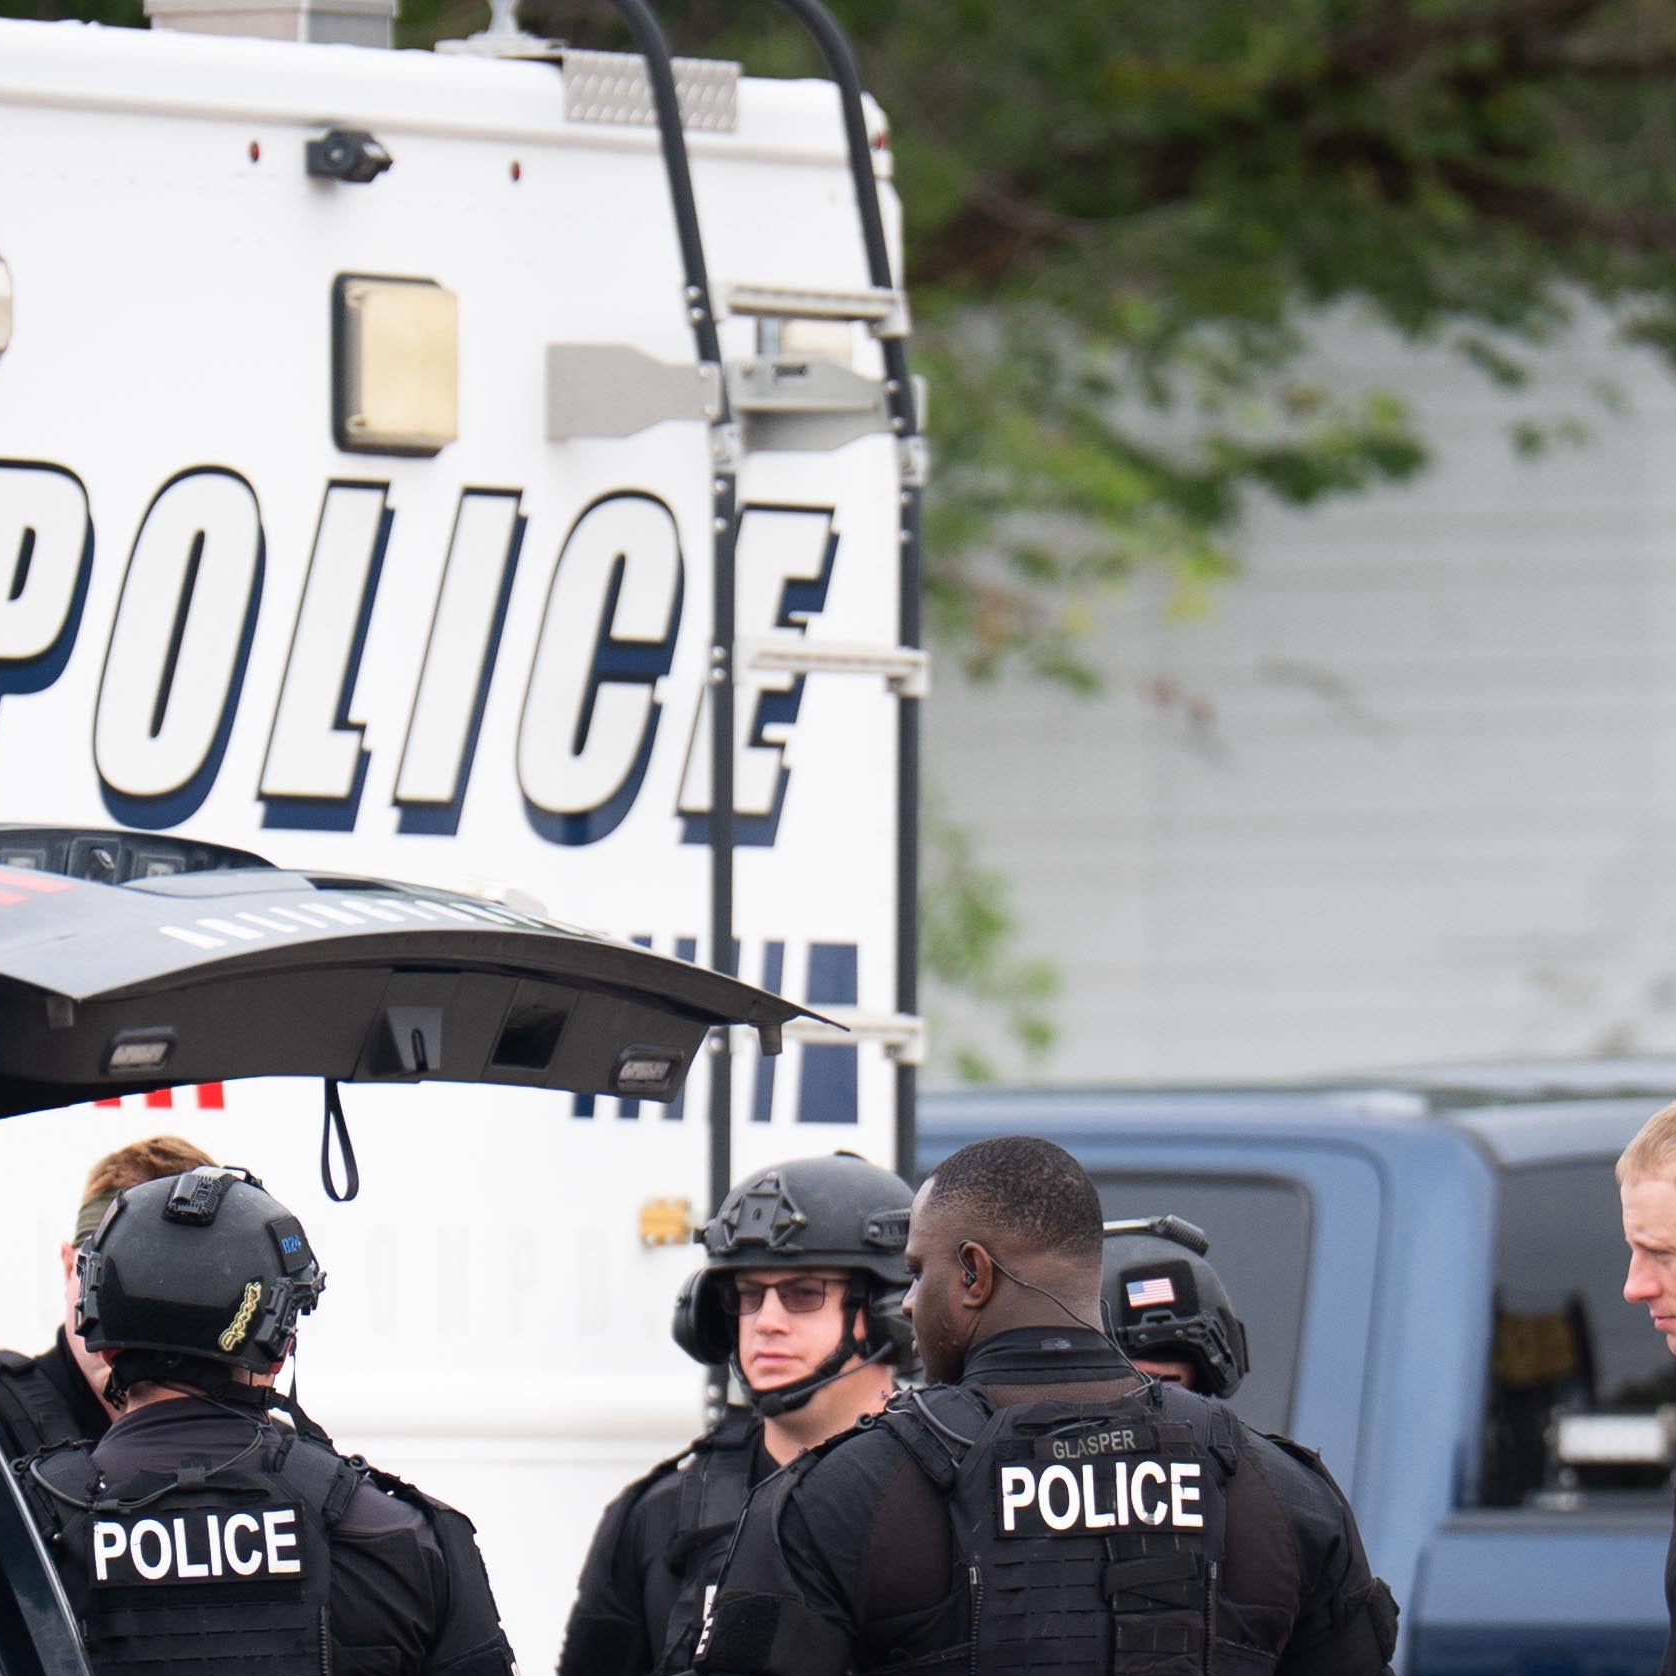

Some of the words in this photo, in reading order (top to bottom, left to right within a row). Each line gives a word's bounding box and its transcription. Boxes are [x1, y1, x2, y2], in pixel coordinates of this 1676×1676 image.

[1053, 1429, 1136, 1460] GLASPER
[1001, 1460, 1204, 1531] POLICE
[93, 1509, 301, 1581] POLICE
